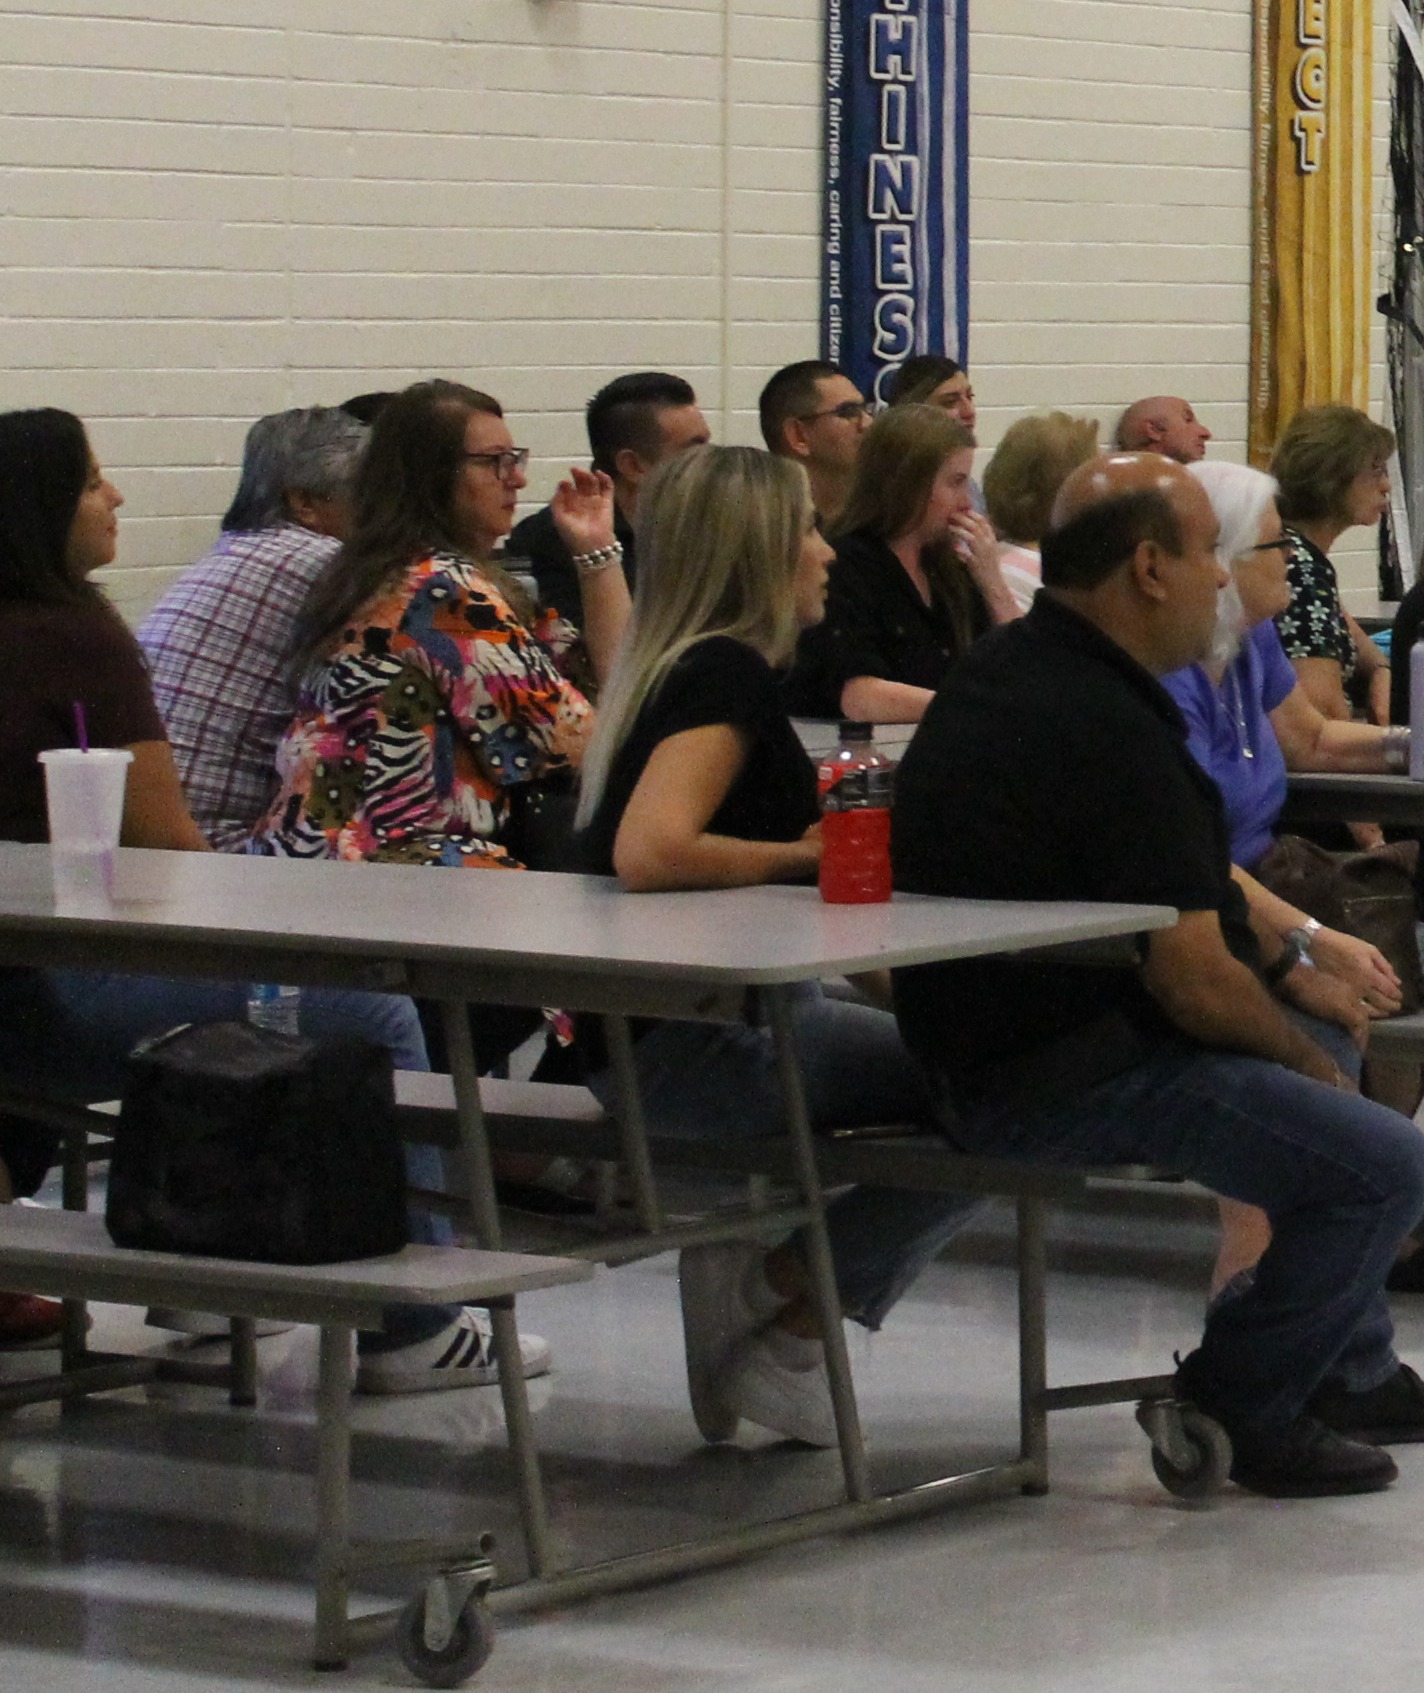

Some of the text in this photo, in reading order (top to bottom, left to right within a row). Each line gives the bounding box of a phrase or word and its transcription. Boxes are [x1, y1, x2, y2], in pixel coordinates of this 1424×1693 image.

[828, 97, 843, 184] fairness,
[827, 190, 843, 254] caring
[829, 260, 843, 299] and
